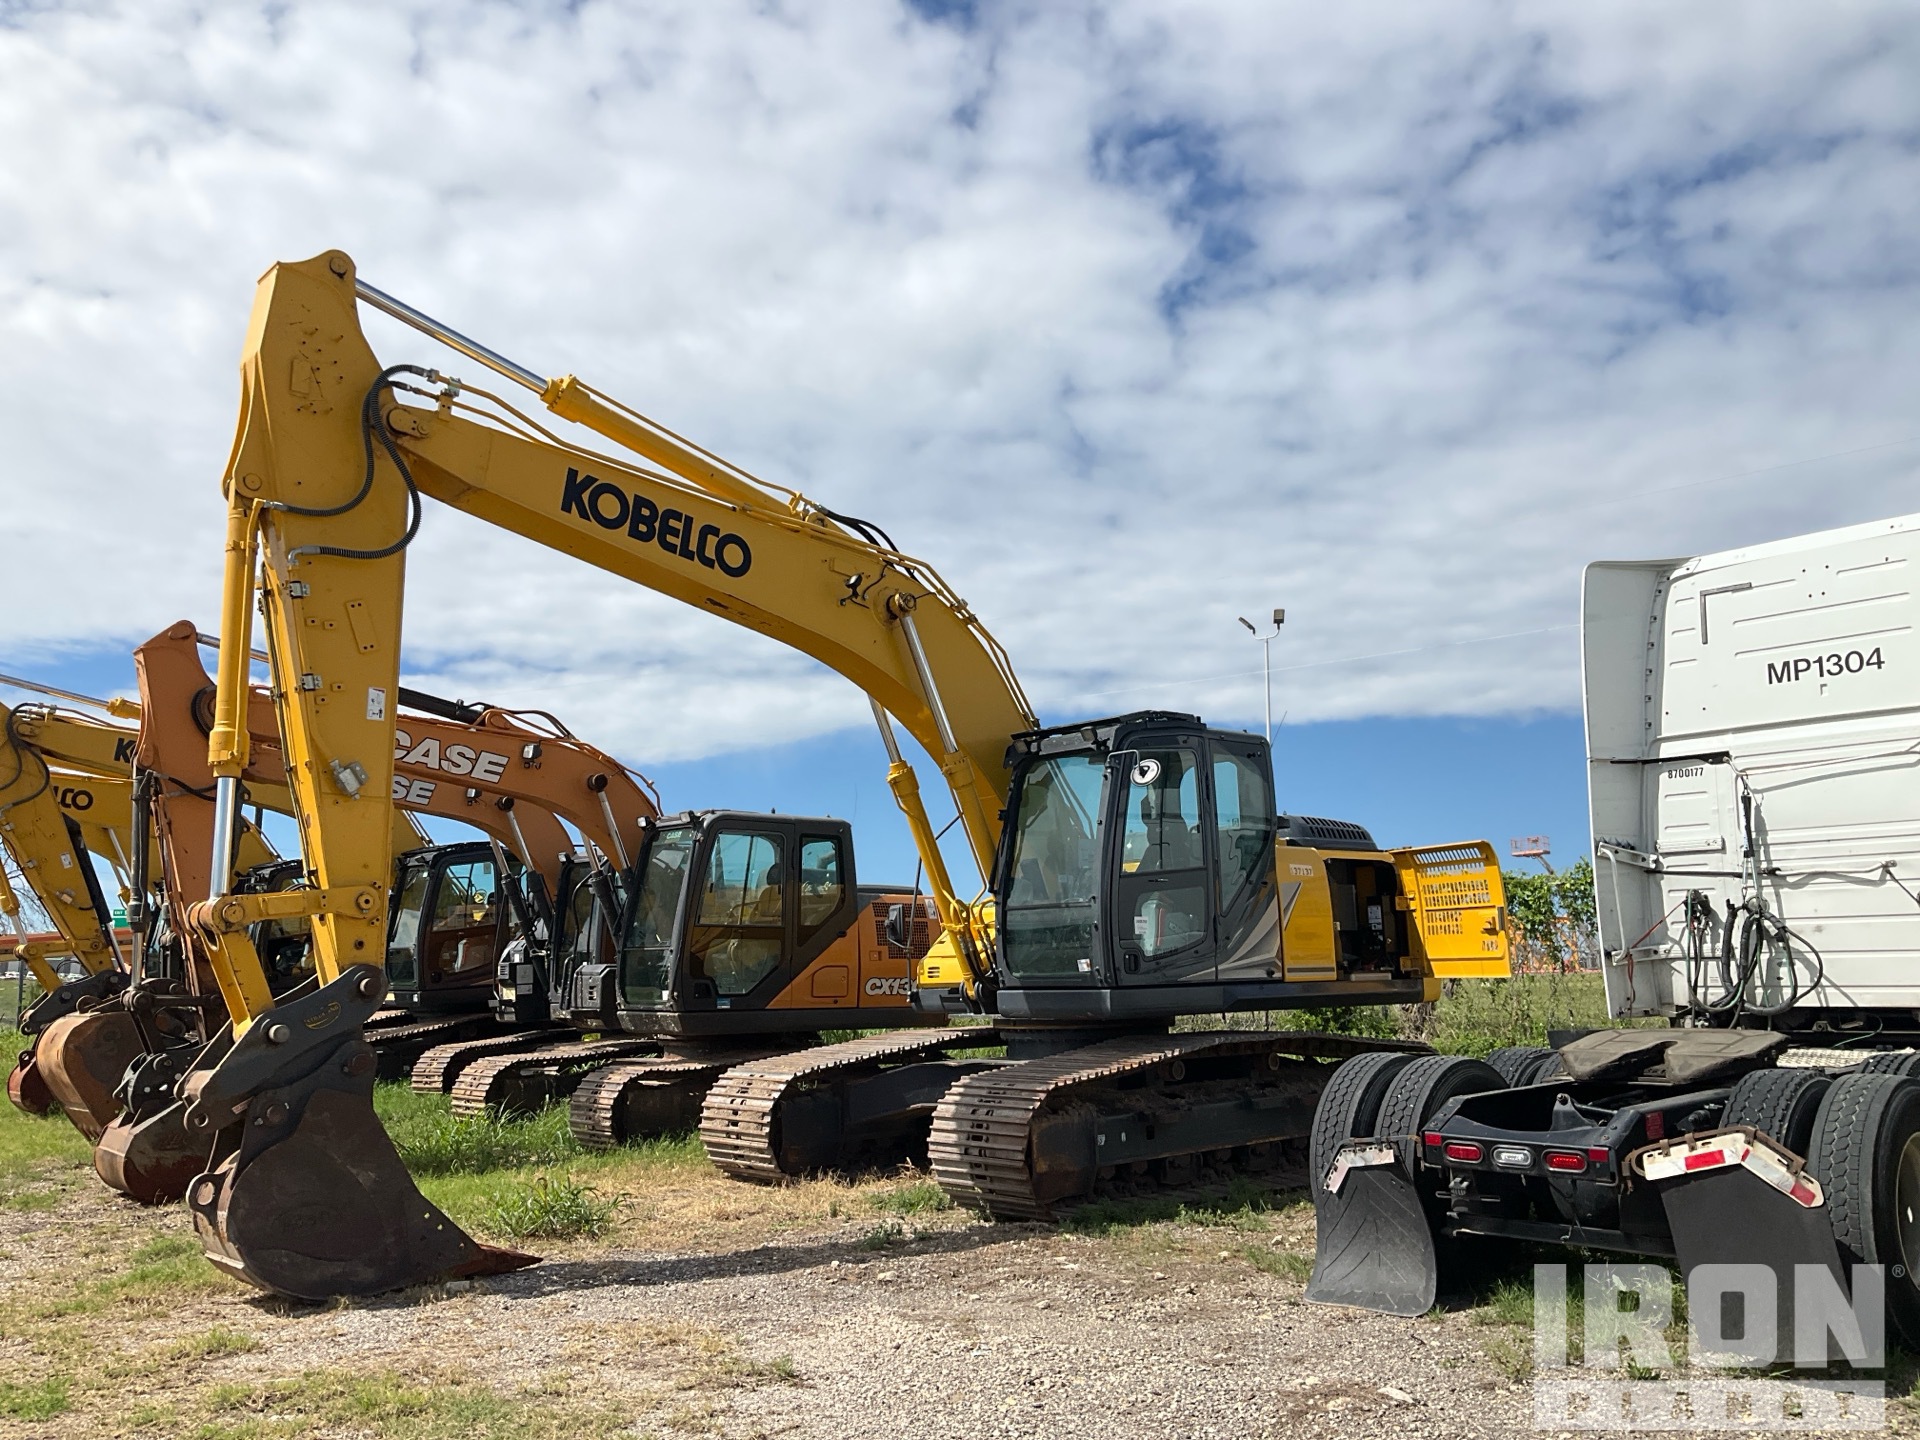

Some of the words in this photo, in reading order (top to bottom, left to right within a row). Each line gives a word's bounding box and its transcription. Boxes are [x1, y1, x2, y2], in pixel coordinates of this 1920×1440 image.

[561, 467, 752, 578] KOBELCO
[1767, 647, 1885, 685] MP1304
[1667, 767, 1704, 779] 8700177
